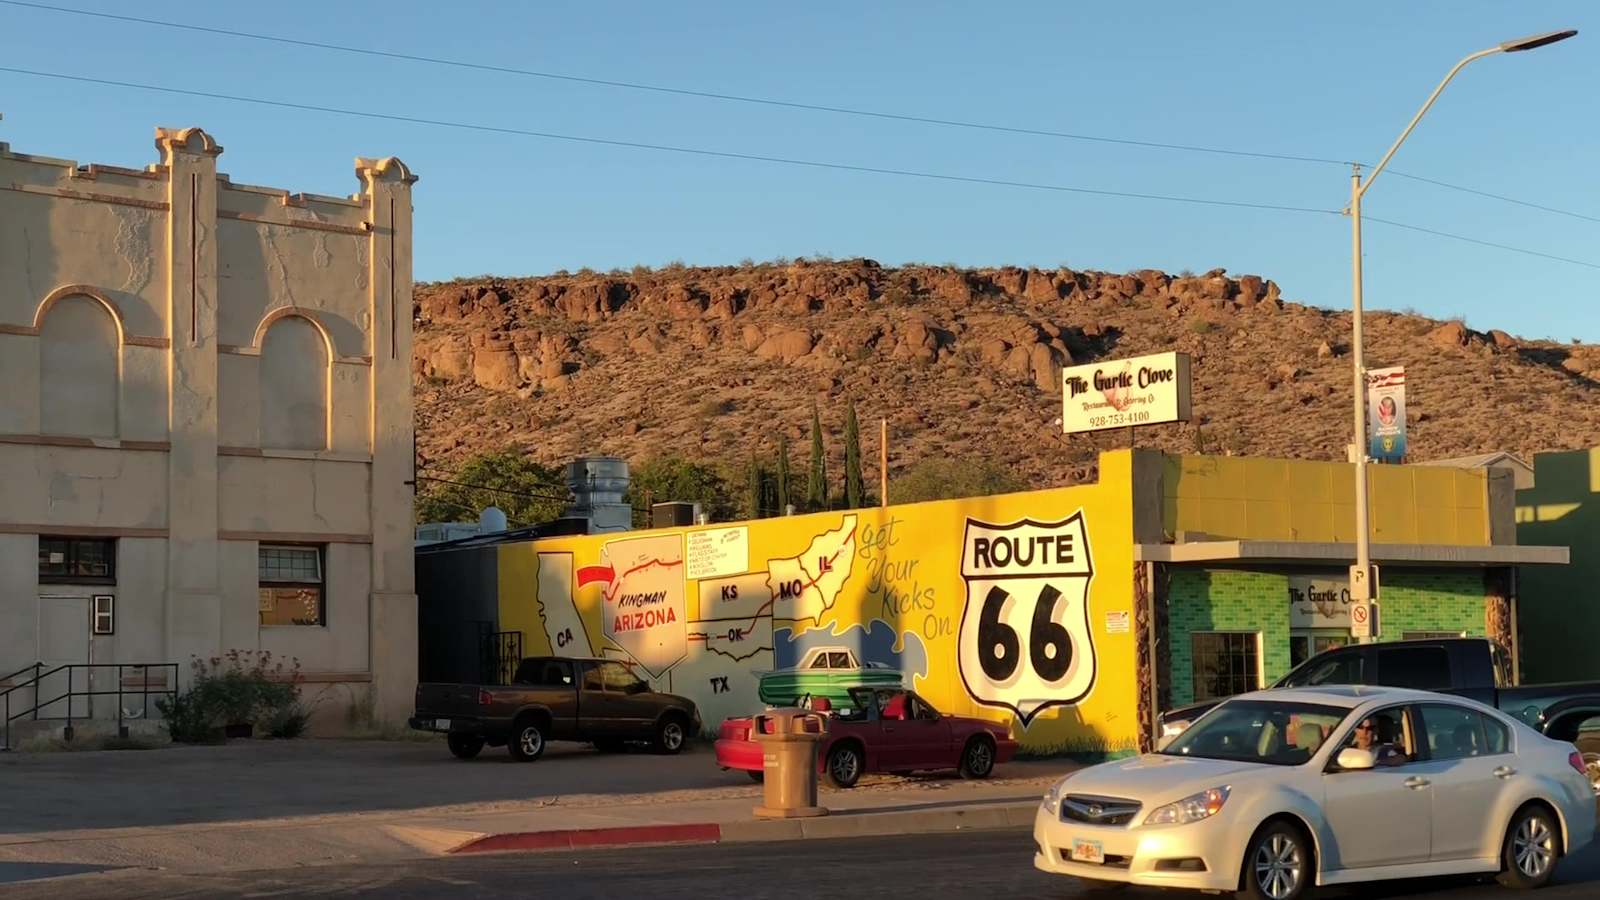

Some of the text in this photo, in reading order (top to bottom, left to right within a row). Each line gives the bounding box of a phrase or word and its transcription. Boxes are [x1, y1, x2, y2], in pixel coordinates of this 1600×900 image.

[1065, 366, 1174, 399] The Garlic Clove
[1089, 411, 1150, 428] 928-753-4100
[859, 515, 904, 559] get
[974, 535, 1074, 568] ROUTE
[819, 556, 833, 571] IL
[866, 554, 919, 594] Your
[618, 590, 667, 608] KINGMAN
[721, 585, 738, 600] KS
[779, 579, 804, 600] MO
[881, 580, 935, 618] Kicks
[1289, 588, 1304, 604] The
[1308, 585, 1337, 602] Garlic
[614, 607, 676, 633] ARIZONA
[923, 614, 953, 640] On
[557, 628, 573, 648] CA
[728, 628, 743, 642] OK
[978, 583, 1073, 682] 66
[710, 676, 731, 694] TX
